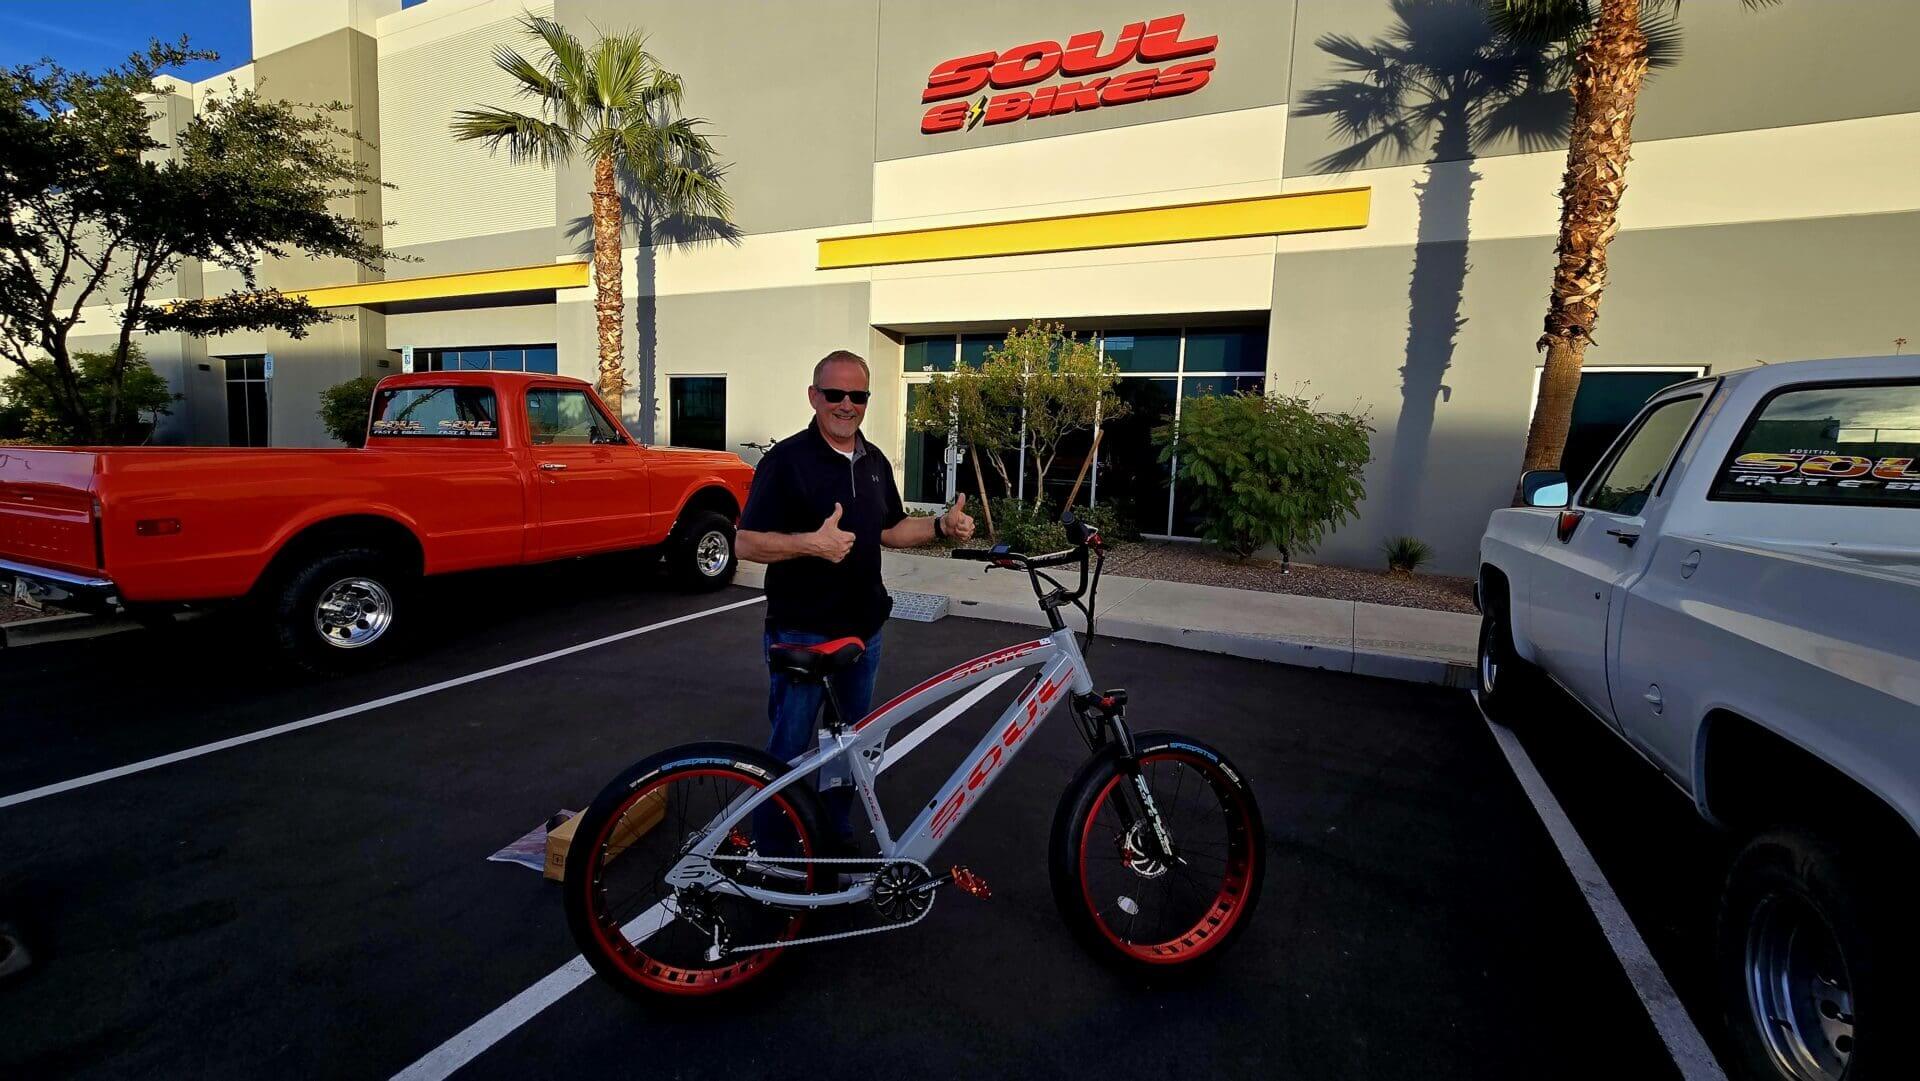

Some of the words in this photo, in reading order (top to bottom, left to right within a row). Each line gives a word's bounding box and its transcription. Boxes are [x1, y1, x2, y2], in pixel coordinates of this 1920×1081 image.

[921, 14, 1218, 104] SOUL
[983, 58, 1216, 126] BIKES
[1735, 475, 1827, 486] FAST
[1790, 448, 1837, 456] POSITION
[929, 666, 1074, 839] SOUL
